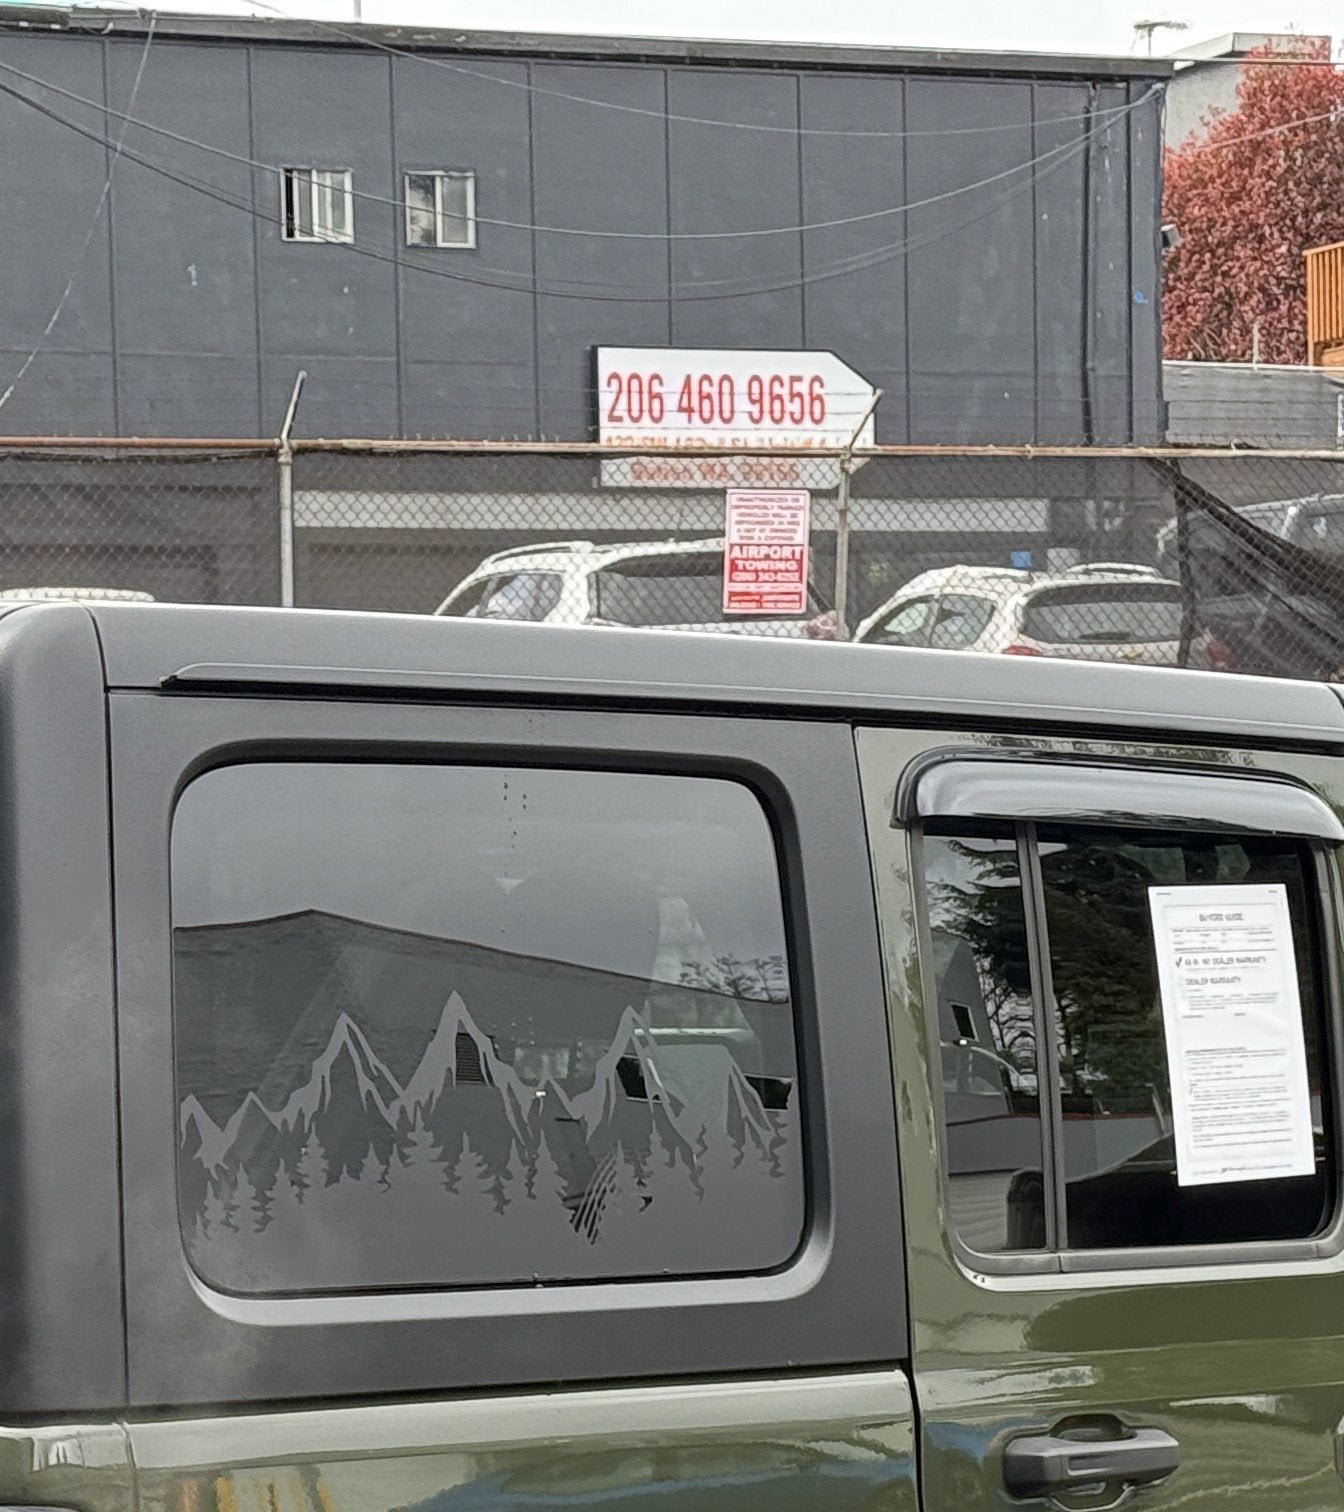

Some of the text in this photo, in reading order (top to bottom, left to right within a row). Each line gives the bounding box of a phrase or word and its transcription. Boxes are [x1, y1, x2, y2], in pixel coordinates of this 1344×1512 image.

[606, 372, 826, 426] 206 460 9656
[730, 545, 803, 560] AIRPORT
